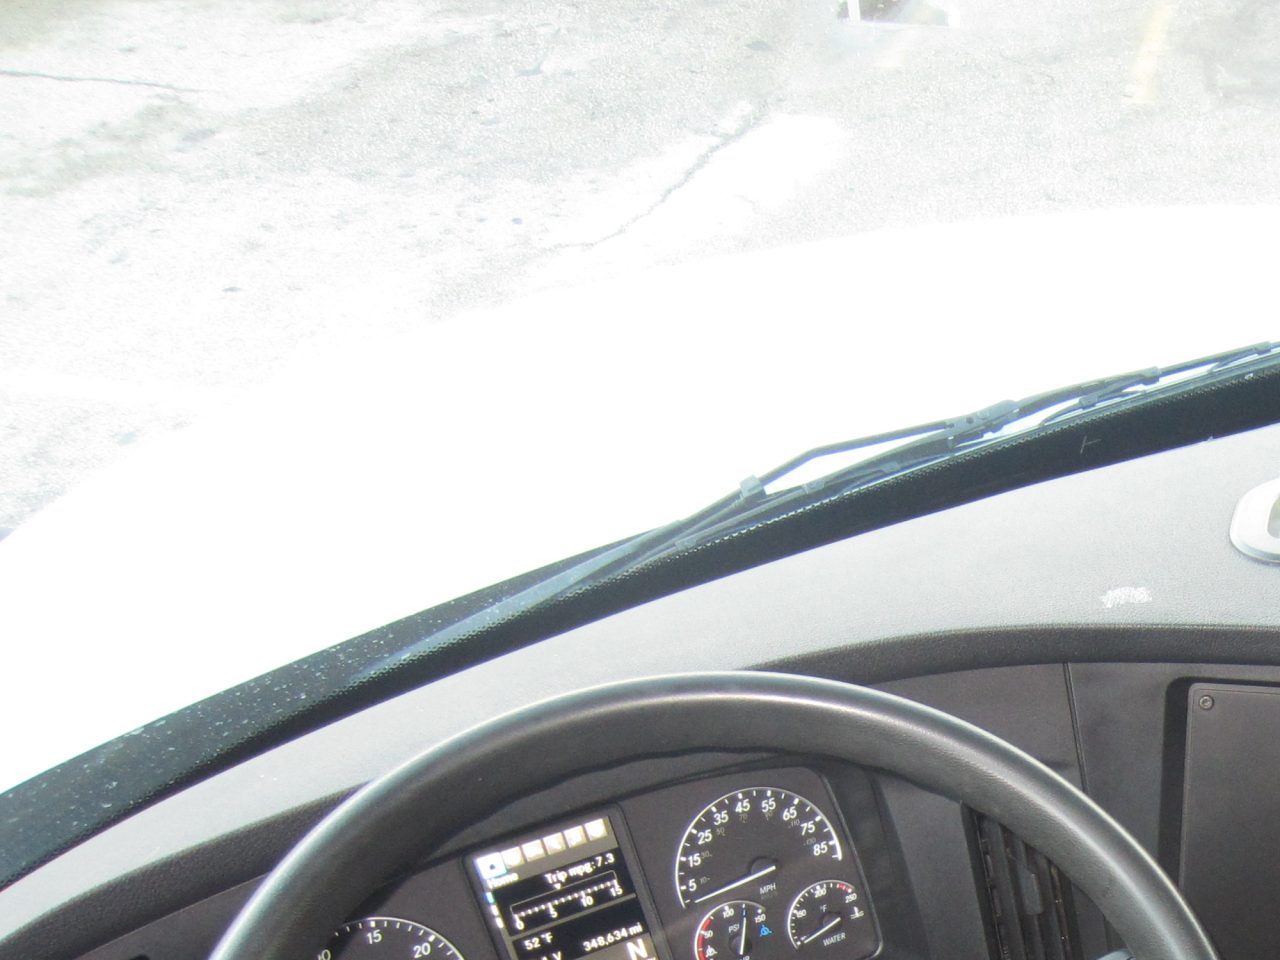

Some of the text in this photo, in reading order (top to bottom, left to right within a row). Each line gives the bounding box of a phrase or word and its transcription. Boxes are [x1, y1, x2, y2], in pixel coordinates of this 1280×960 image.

[735, 799, 750, 813] 45
[761, 798, 776, 812] 55
[713, 811, 728, 825] 35
[783, 807, 797, 821] 65
[801, 822, 815, 835] 75
[697, 830, 712, 844] 25
[813, 842, 828, 856] 85
[688, 854, 701, 868] 15
[544, 869, 567, 883] Trip
[610, 885, 623, 897] 15
[689, 879, 697, 891] 5
[759, 883, 776, 895] MPH
[814, 888, 827, 898] 200
[845, 893, 857, 903] 250
[581, 896, 594, 908] 10
[551, 908, 558, 918] 5
[723, 908, 734, 919] 100
[754, 914, 766, 924] 150
[516, 918, 525, 930] 0
[366, 929, 382, 944] 15
[524, 936, 541, 950] 52
[582, 922, 643, 952] 348,634 mi
[823, 933, 846, 947] WATER
[413, 943, 431, 958] 20
